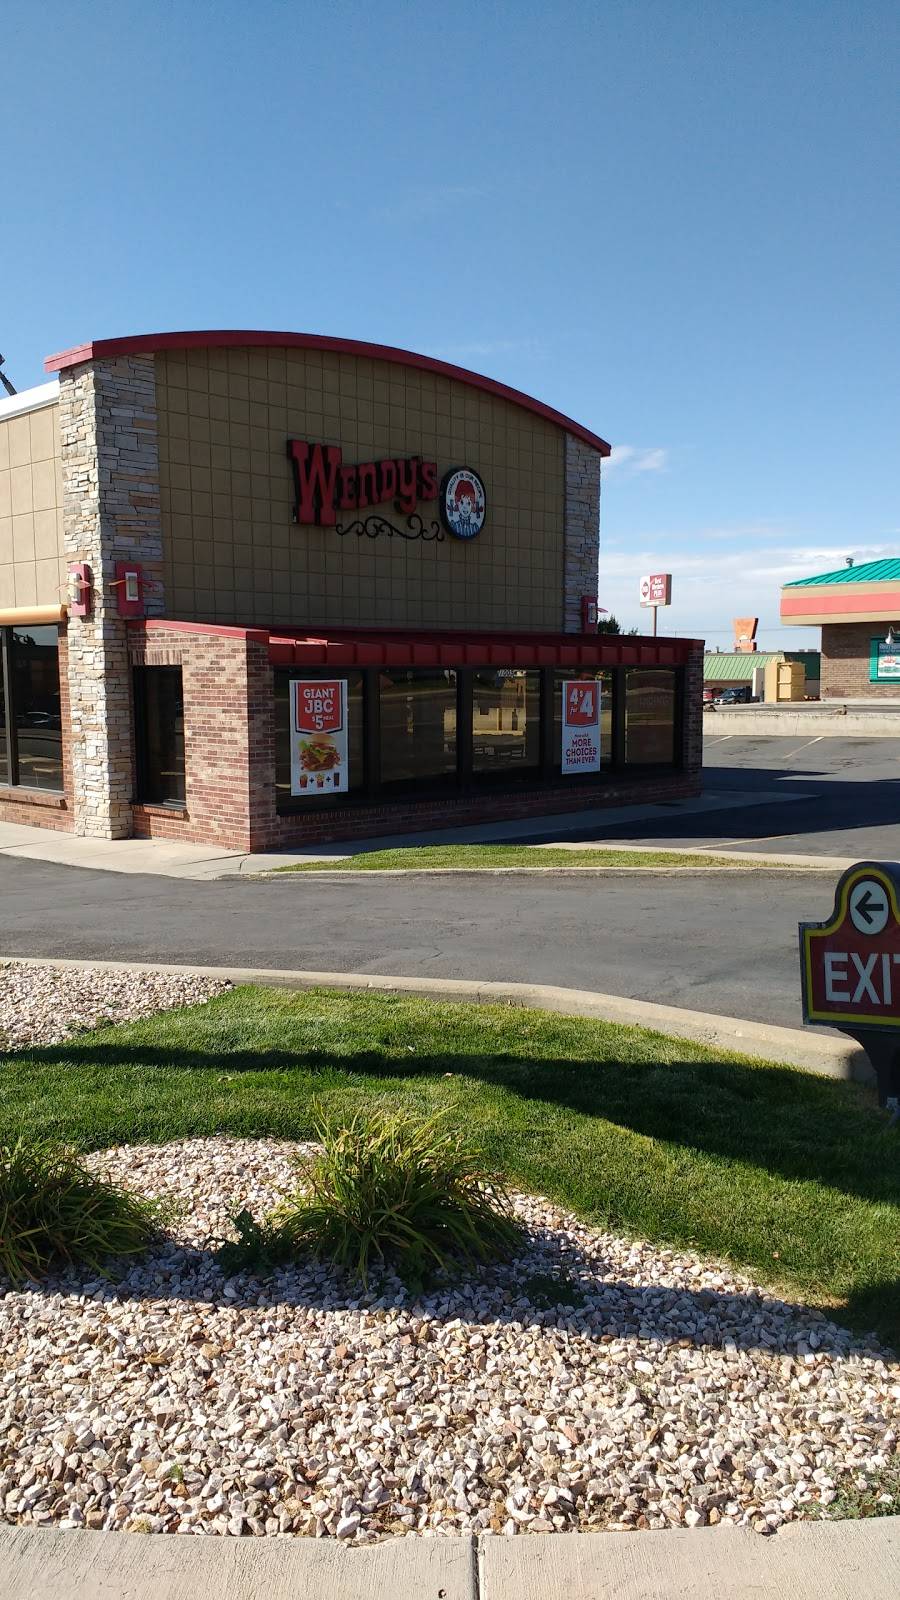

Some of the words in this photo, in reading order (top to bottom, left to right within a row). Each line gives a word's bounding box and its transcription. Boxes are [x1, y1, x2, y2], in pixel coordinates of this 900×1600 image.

[287, 440, 439, 527] Wendy's
[303, 688, 335, 699] GIANT
[304, 699, 334, 714] JBC
[571, 738, 592, 748] MORE
[565, 748, 597, 758] CHOICES
[566, 757, 581, 766] THAN
[823, 951, 900, 1006] EXI
